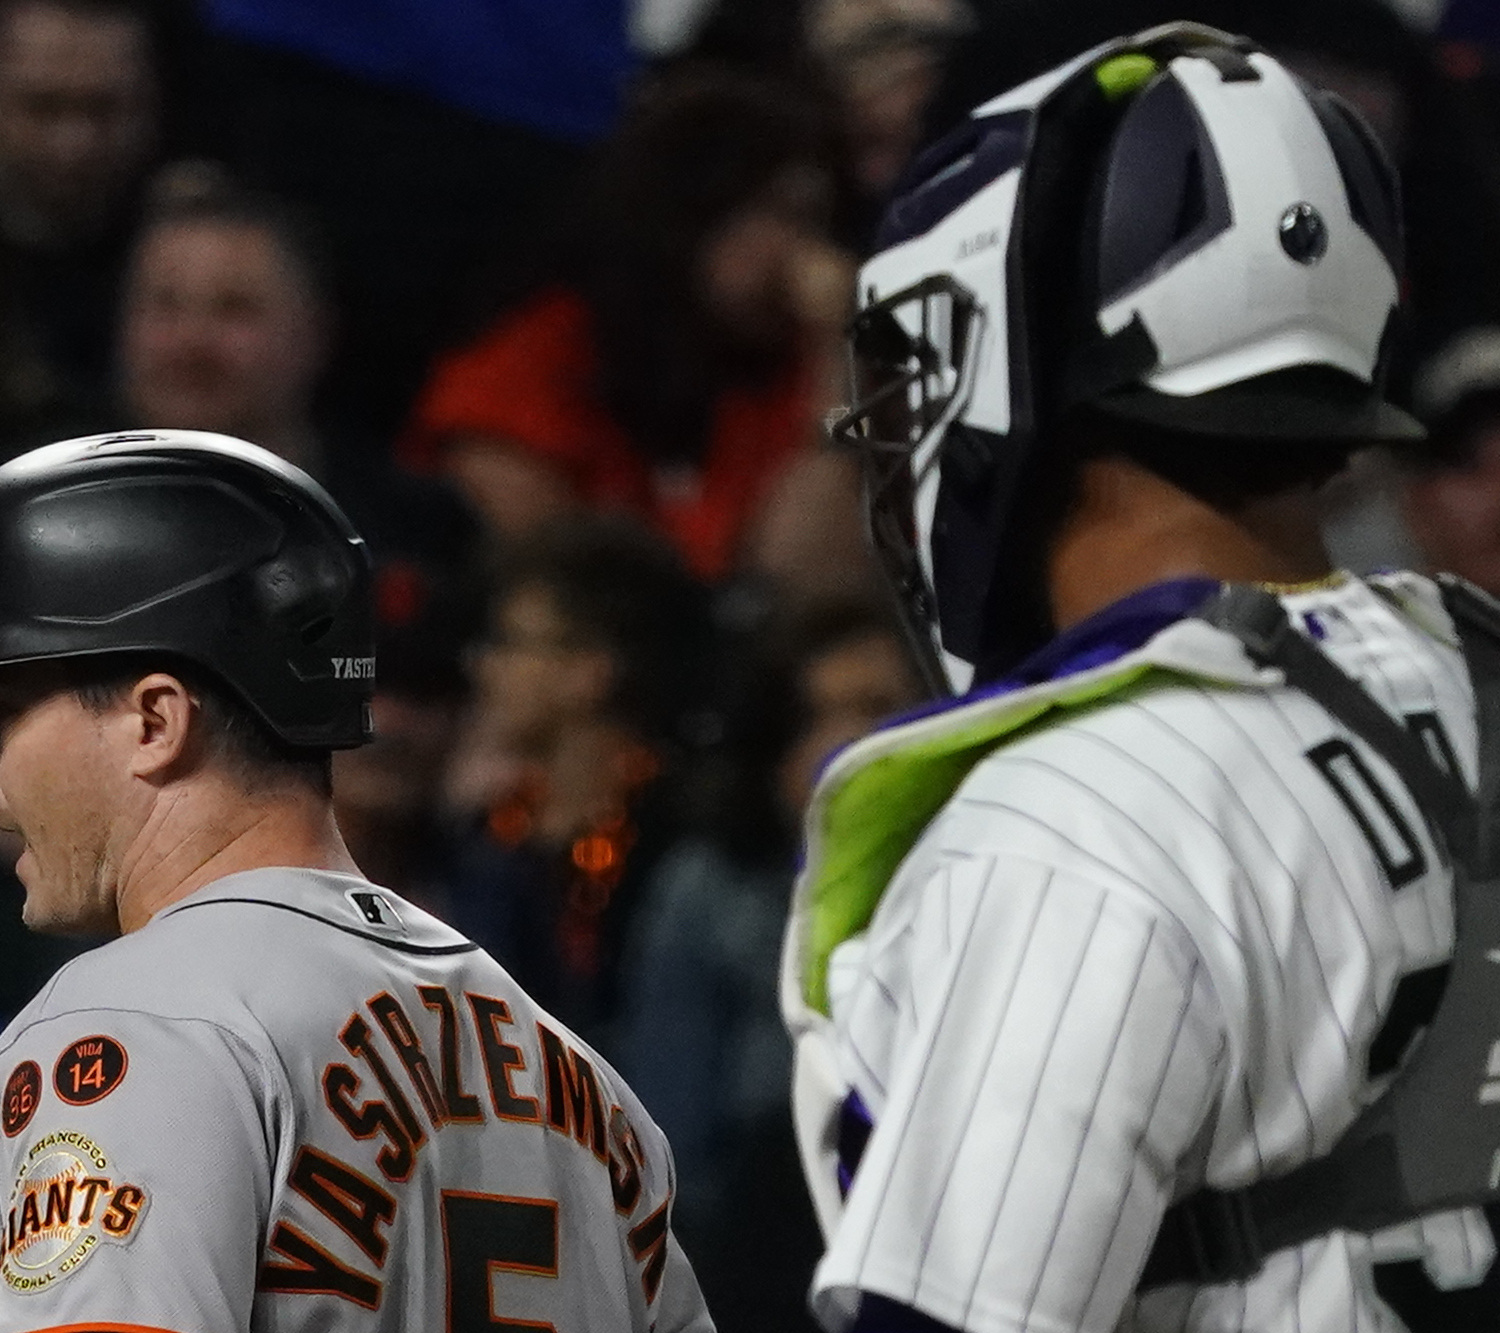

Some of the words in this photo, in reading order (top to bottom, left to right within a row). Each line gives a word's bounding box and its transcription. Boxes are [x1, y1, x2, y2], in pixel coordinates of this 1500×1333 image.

[75, 1042, 105, 1060] VIDA
[68, 1058, 107, 1094] 14
[8, 1082, 34, 1126] 36
[28, 1130, 107, 1170] FRANCISCO
[58, 1233, 98, 1273] CLUB
